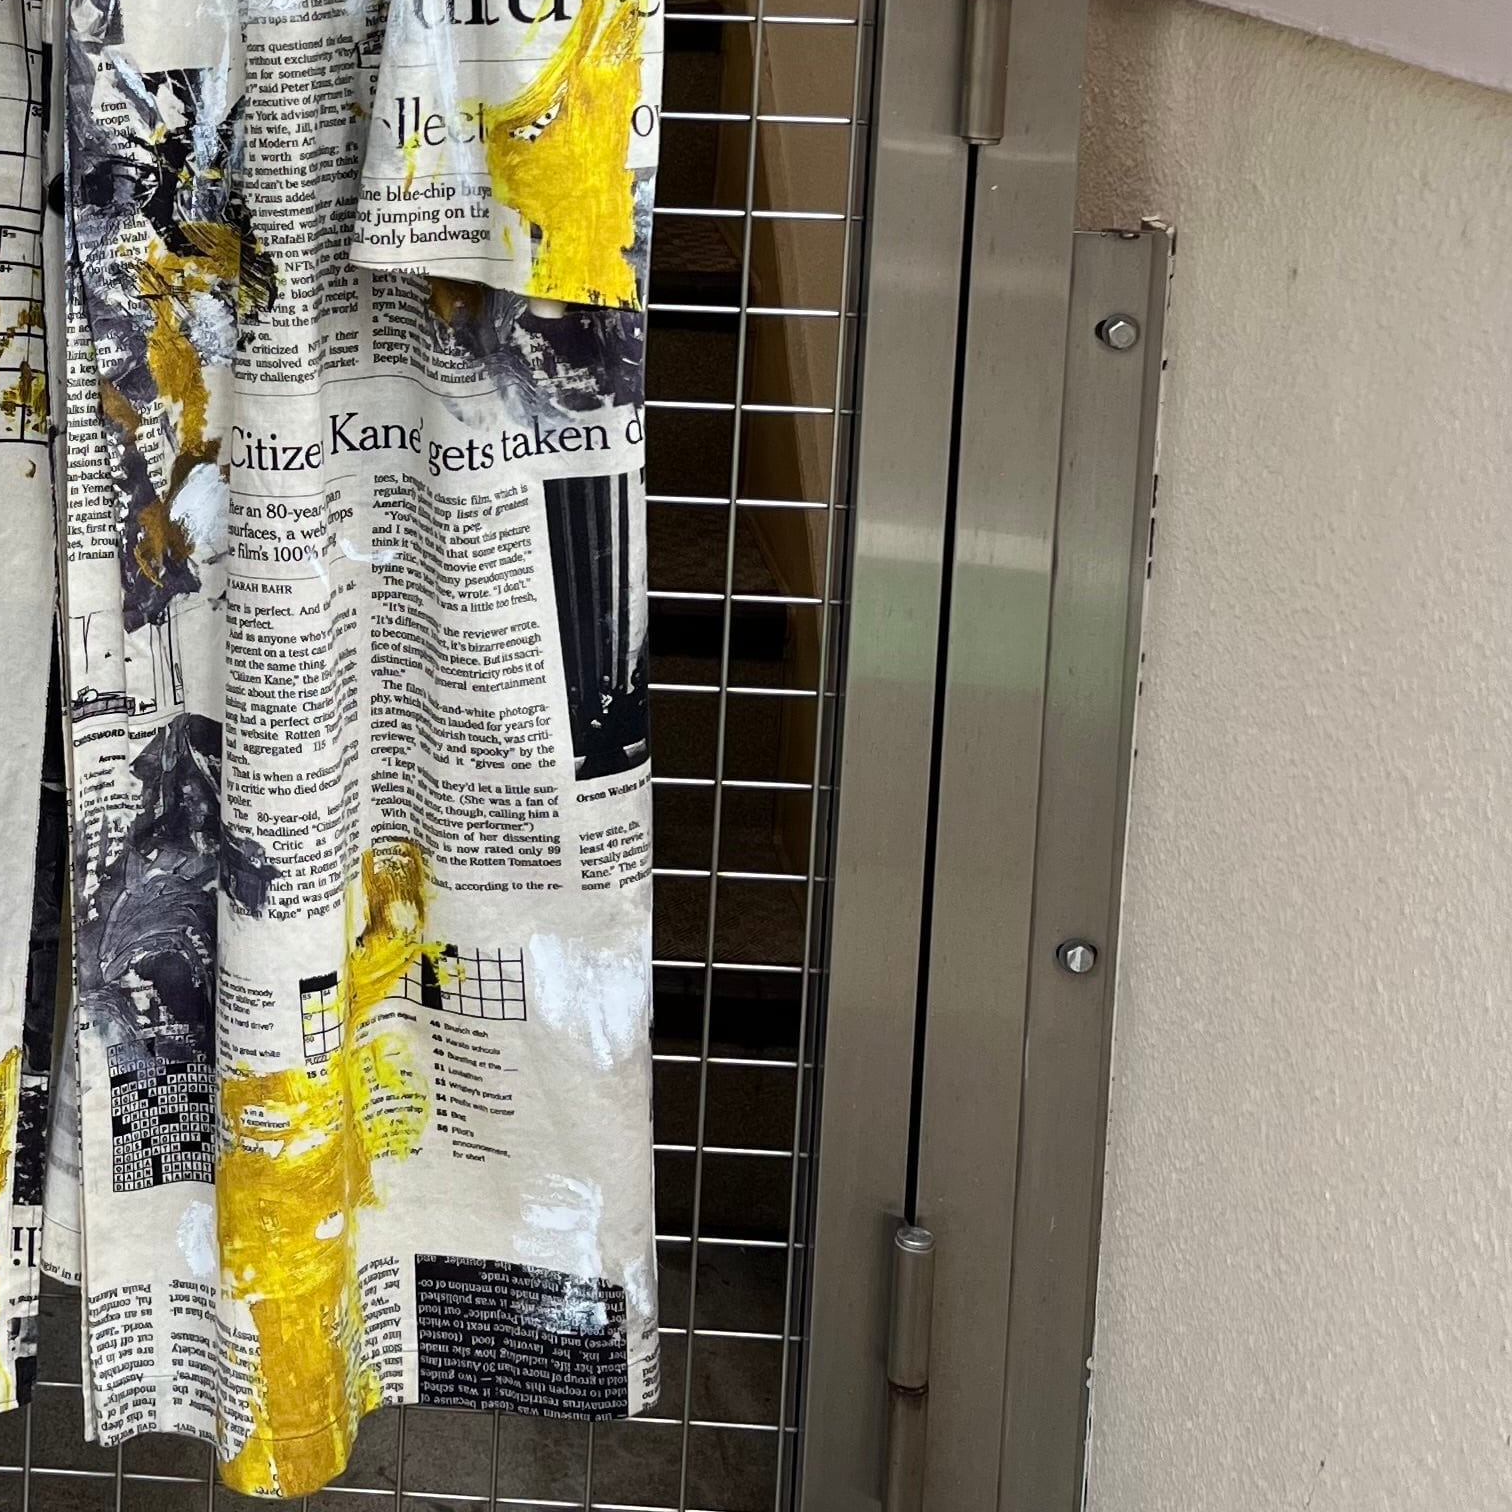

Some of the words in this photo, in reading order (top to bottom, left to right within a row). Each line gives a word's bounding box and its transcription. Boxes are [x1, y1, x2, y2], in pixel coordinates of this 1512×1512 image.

[386, 183, 456, 201] blue-chip
[375, 205, 440, 225] jumping
[444, 207, 465, 220] on
[230, 424, 324, 472] Citize
[428, 439, 495, 477] gets
[501, 415, 611, 462] taken
